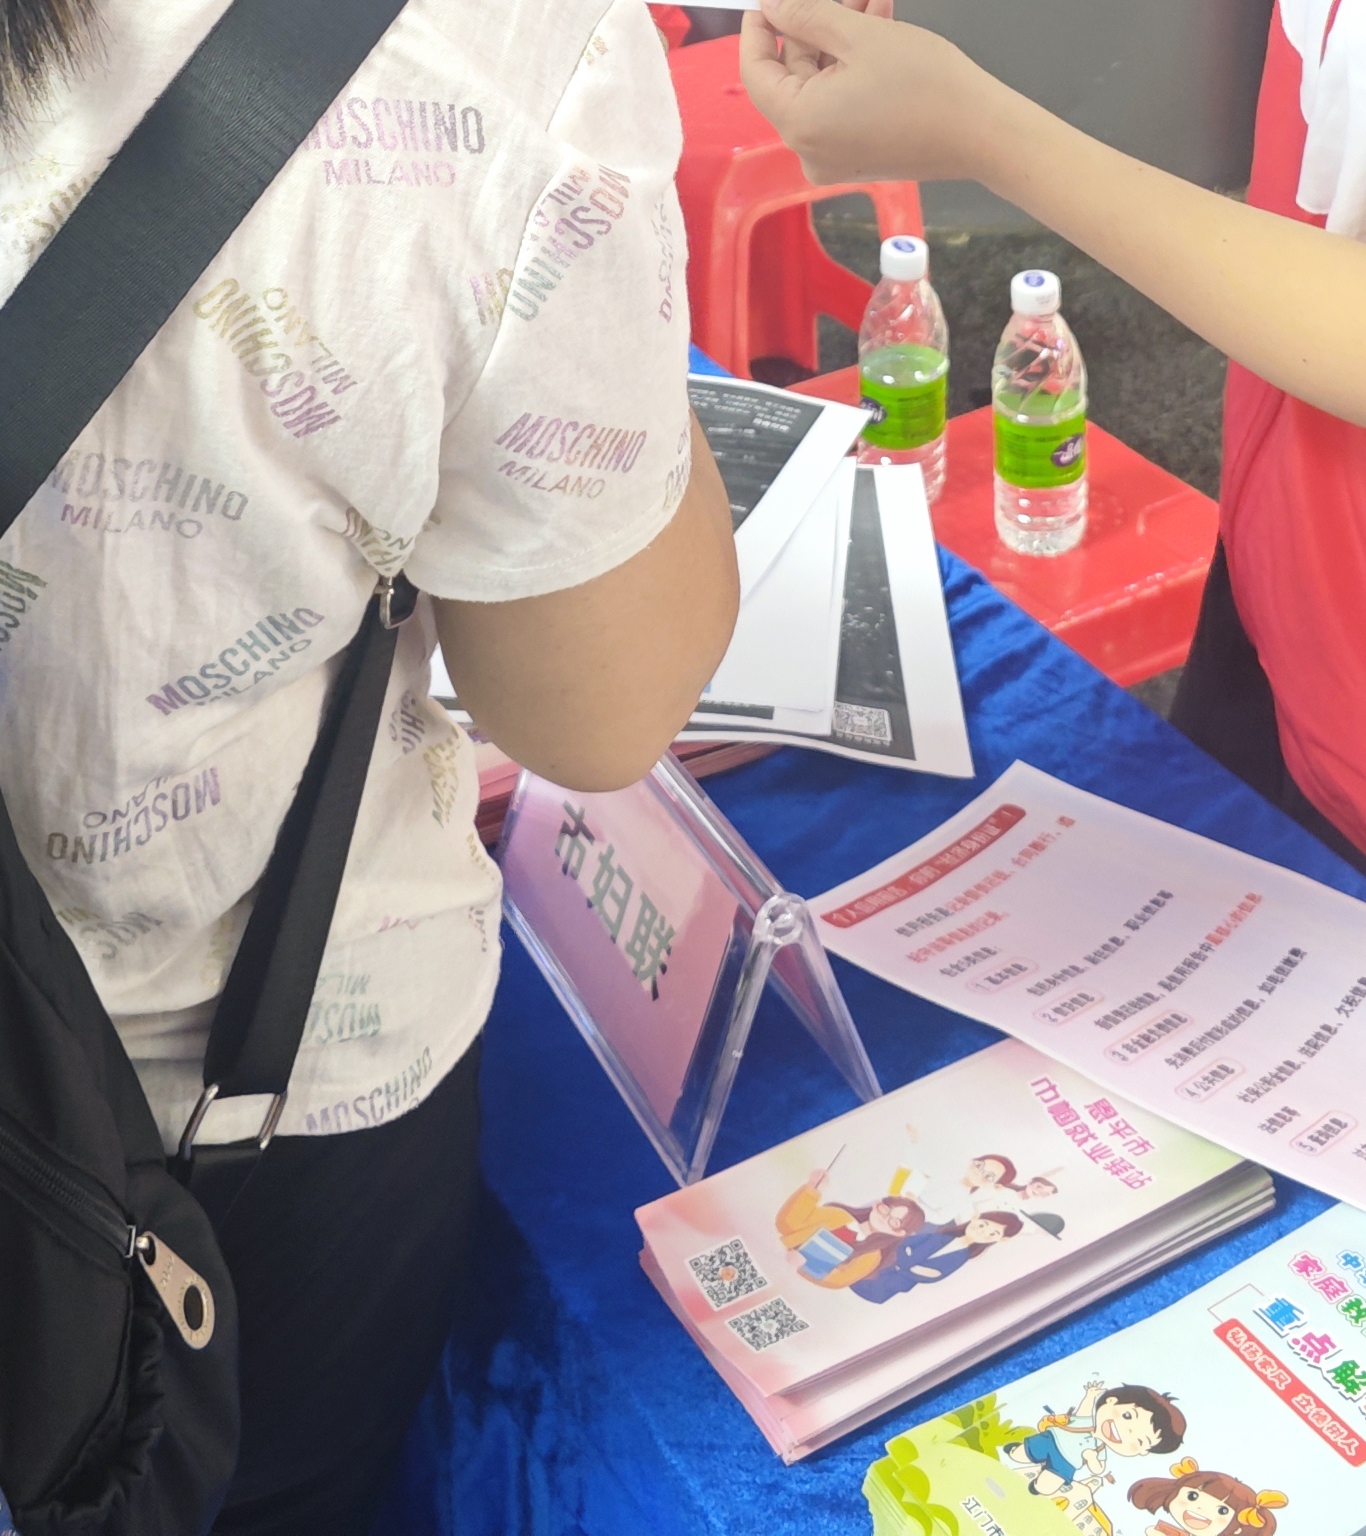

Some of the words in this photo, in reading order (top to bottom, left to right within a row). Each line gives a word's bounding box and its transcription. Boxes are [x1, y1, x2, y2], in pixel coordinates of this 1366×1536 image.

[323, 159, 456, 188] MILANO
[193, 277, 341, 439] MOSCHINO
[495, 412, 647, 473] MOSCHINO
[498, 460, 606, 499] MILANO
[61, 503, 203, 538] MILANO
[146, 607, 325, 715] MOSCHINO
[47, 767, 221, 864] MOSCHINO
[554, 800, 677, 1001] 市妇联
[1030, 1076, 1153, 1190] 巾帼就业驿站
[1083, 1097, 1156, 1157] 恩平市
[1226, 1328, 1291, 1390] 弘扬家风
